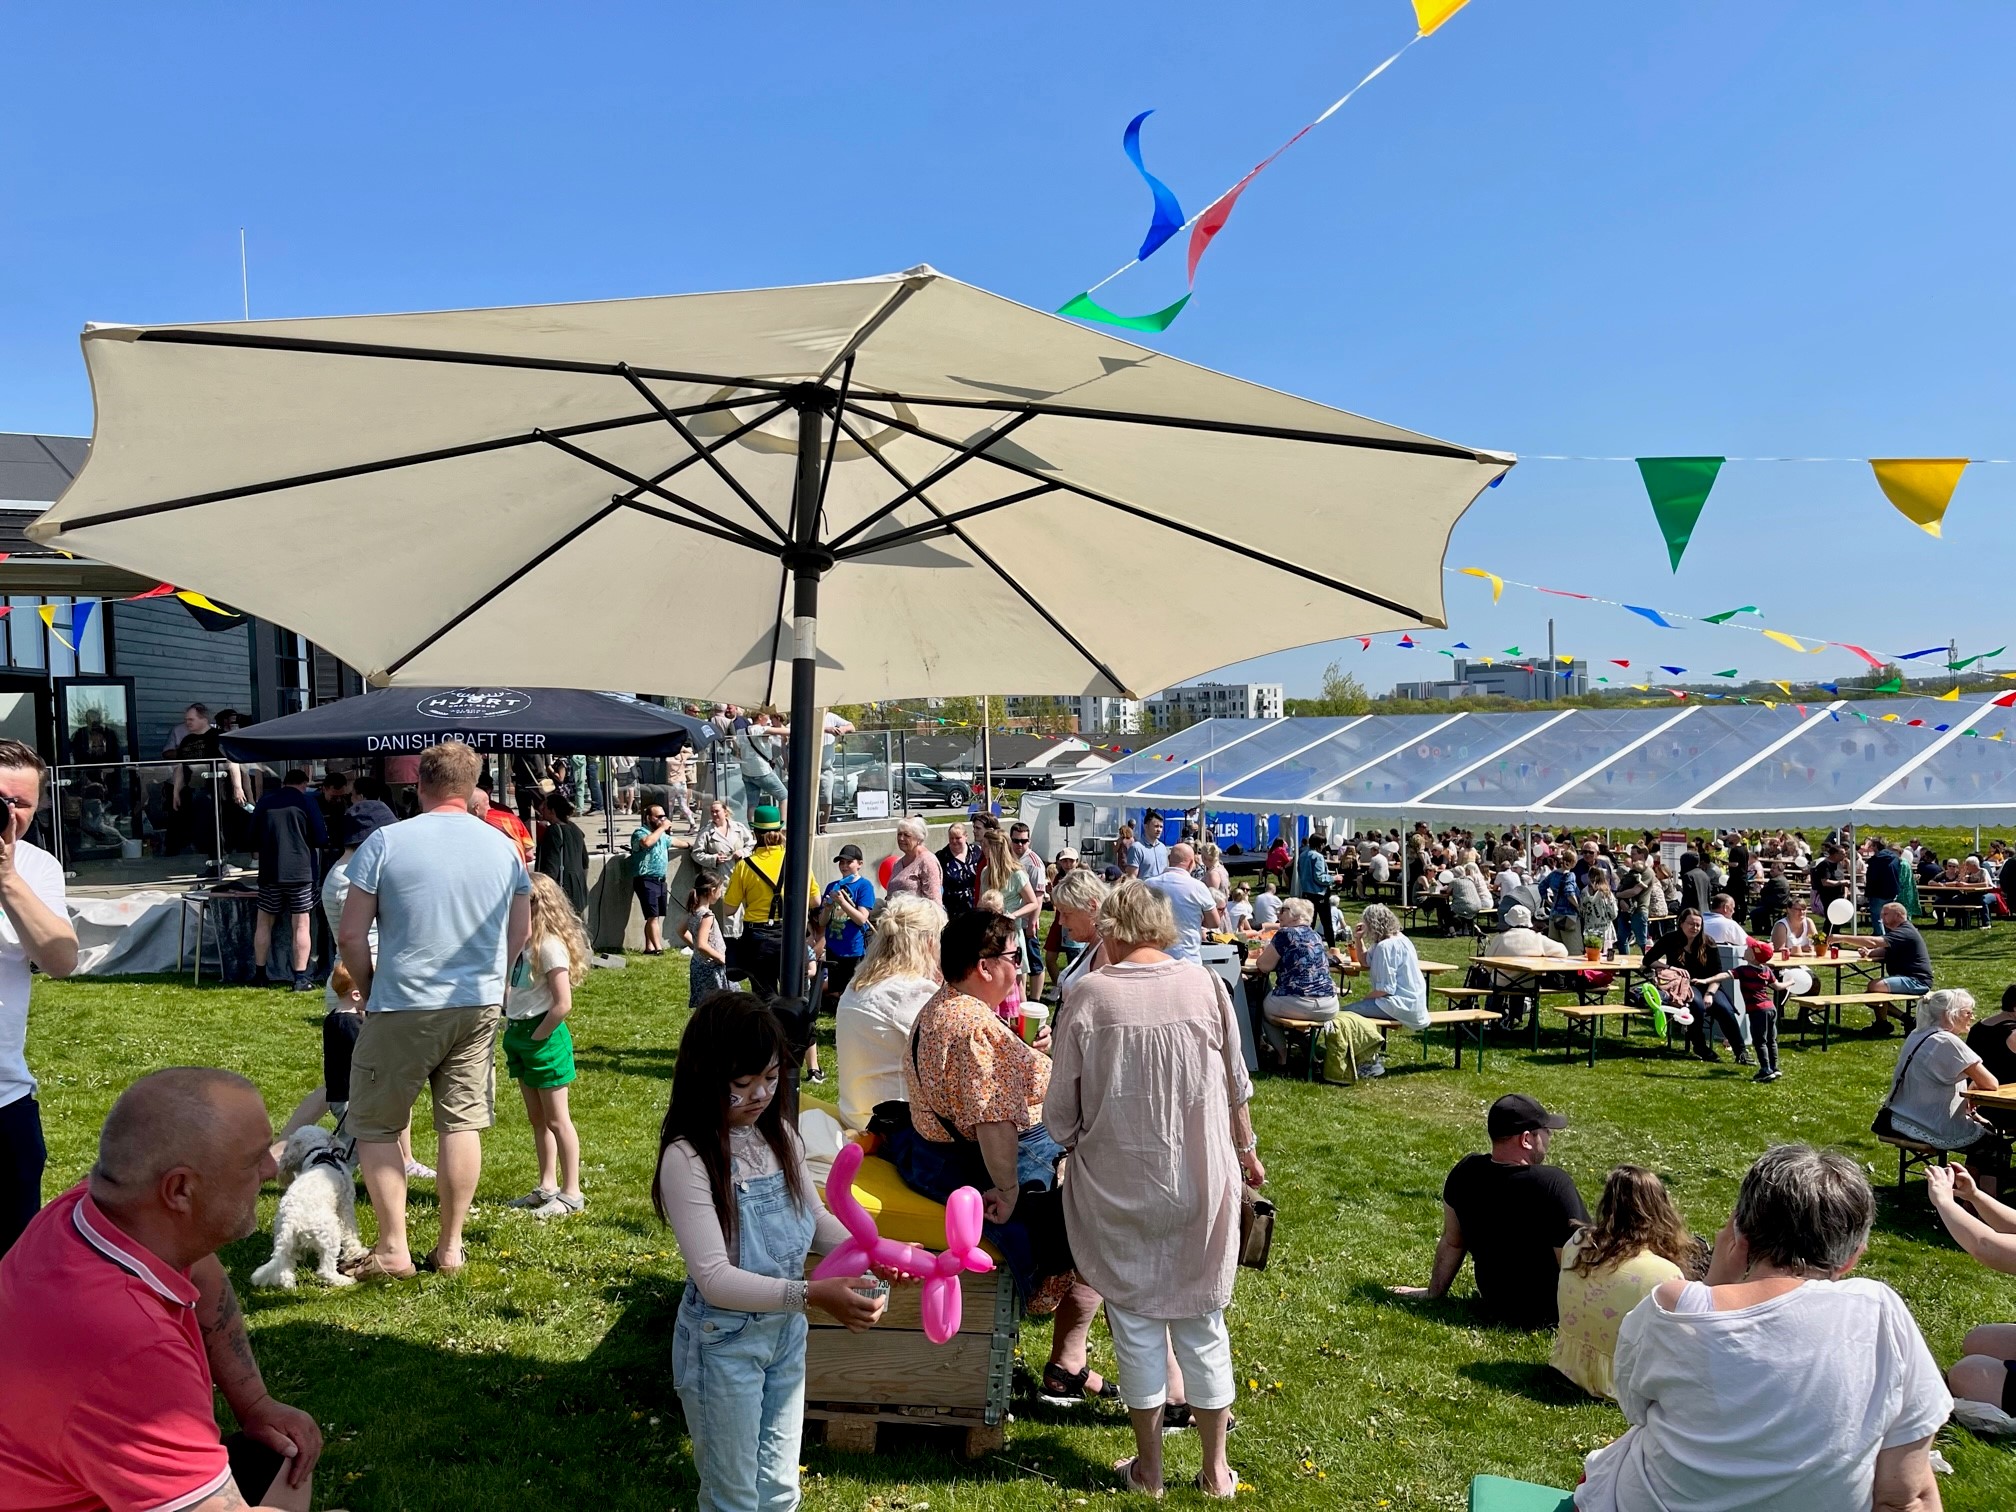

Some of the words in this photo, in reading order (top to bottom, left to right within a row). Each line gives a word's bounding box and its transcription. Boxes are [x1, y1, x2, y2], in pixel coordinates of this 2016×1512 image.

[429, 698, 521, 706] HJORT
[367, 733, 435, 751] DANISH
[502, 733, 546, 749] BEER
